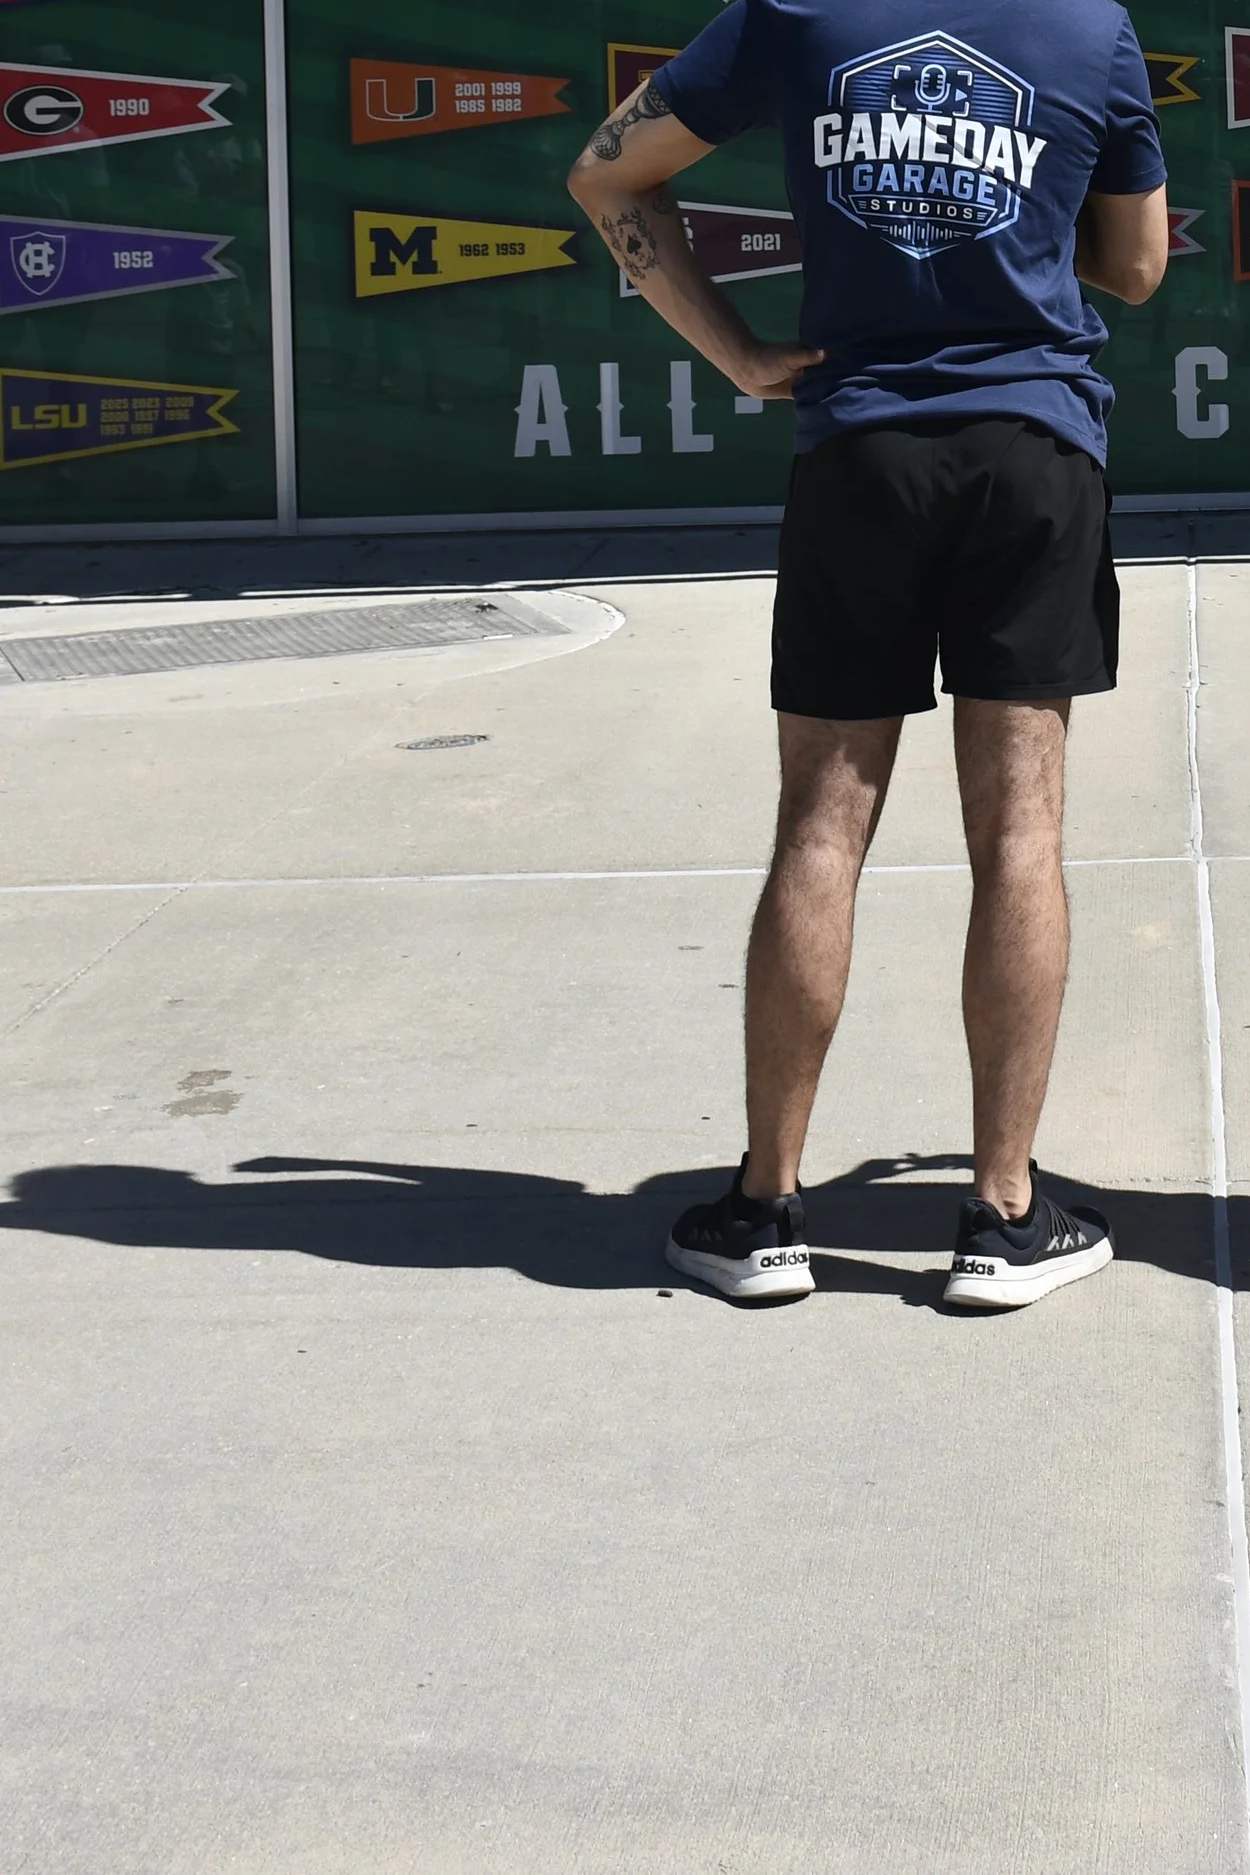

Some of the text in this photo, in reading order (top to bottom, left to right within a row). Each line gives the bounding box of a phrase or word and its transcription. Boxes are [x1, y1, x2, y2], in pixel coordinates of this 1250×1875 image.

[365, 77, 436, 122] U
[455, 82, 522, 97] 2001 1999
[109, 98, 149, 118] 1990
[455, 98, 522, 113] 1985 1982
[813, 112, 1047, 190] GAMEDAY
[852, 163, 998, 206] GARAGE
[870, 199, 974, 219] STUDIOS
[369, 226, 526, 275] M 1962 1953
[741, 233, 781, 251] 2021
[113, 251, 153, 269] 1952
[11, 403, 87, 430] LSU
[514, 361, 764, 457] ALL-
[760, 1250, 809, 1268] adida
[952, 1258, 995, 1276] didas
